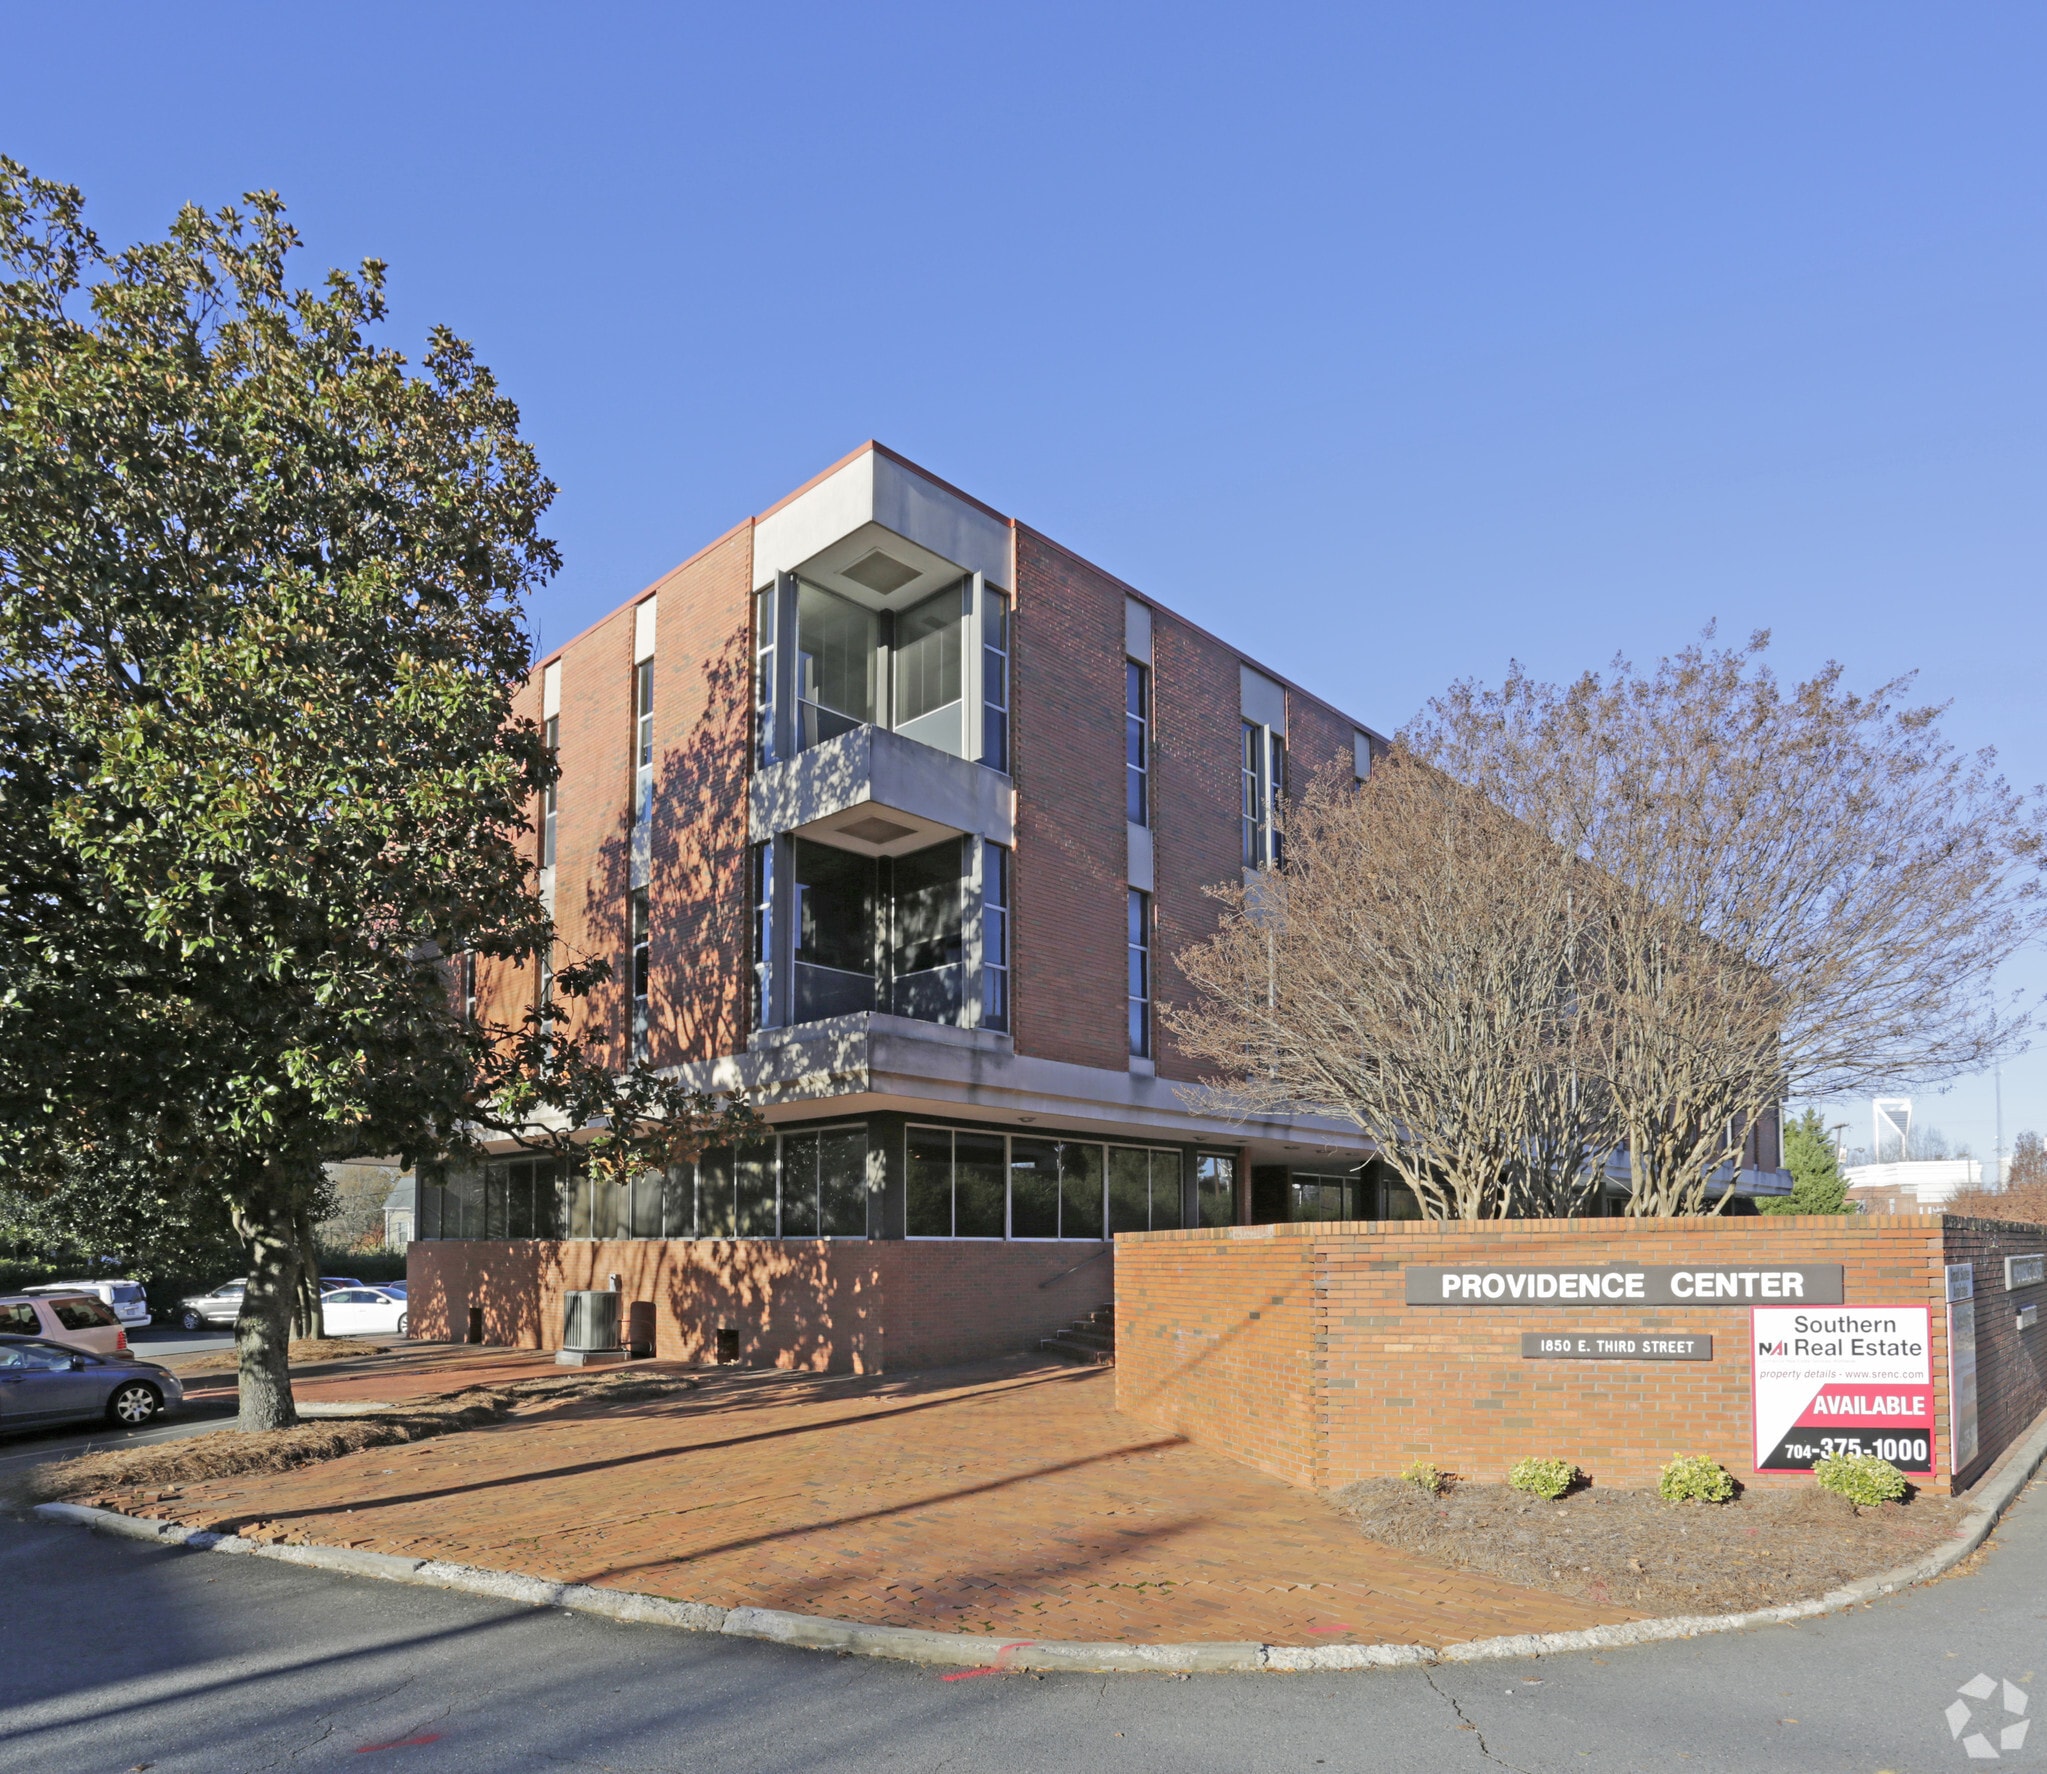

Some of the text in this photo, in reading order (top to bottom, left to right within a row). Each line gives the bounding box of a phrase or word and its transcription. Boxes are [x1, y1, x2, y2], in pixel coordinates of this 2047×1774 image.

[1442, 1272, 1804, 1299] PROVIDENCE CENTER
[1794, 1315, 1896, 1333] Southern
[1541, 1339, 1695, 1354] 1850 E. THIRD STREET
[1759, 1339, 1922, 1356] NAI Real Estate
[1760, 1370, 1801, 1380] property
[1804, 1369, 1837, 1379] details
[1845, 1370, 1924, 1379] www.srenc.com
[1812, 1395, 1926, 1416] AVAILABLE
[1784, 1437, 1928, 1462] 704-375-1000
